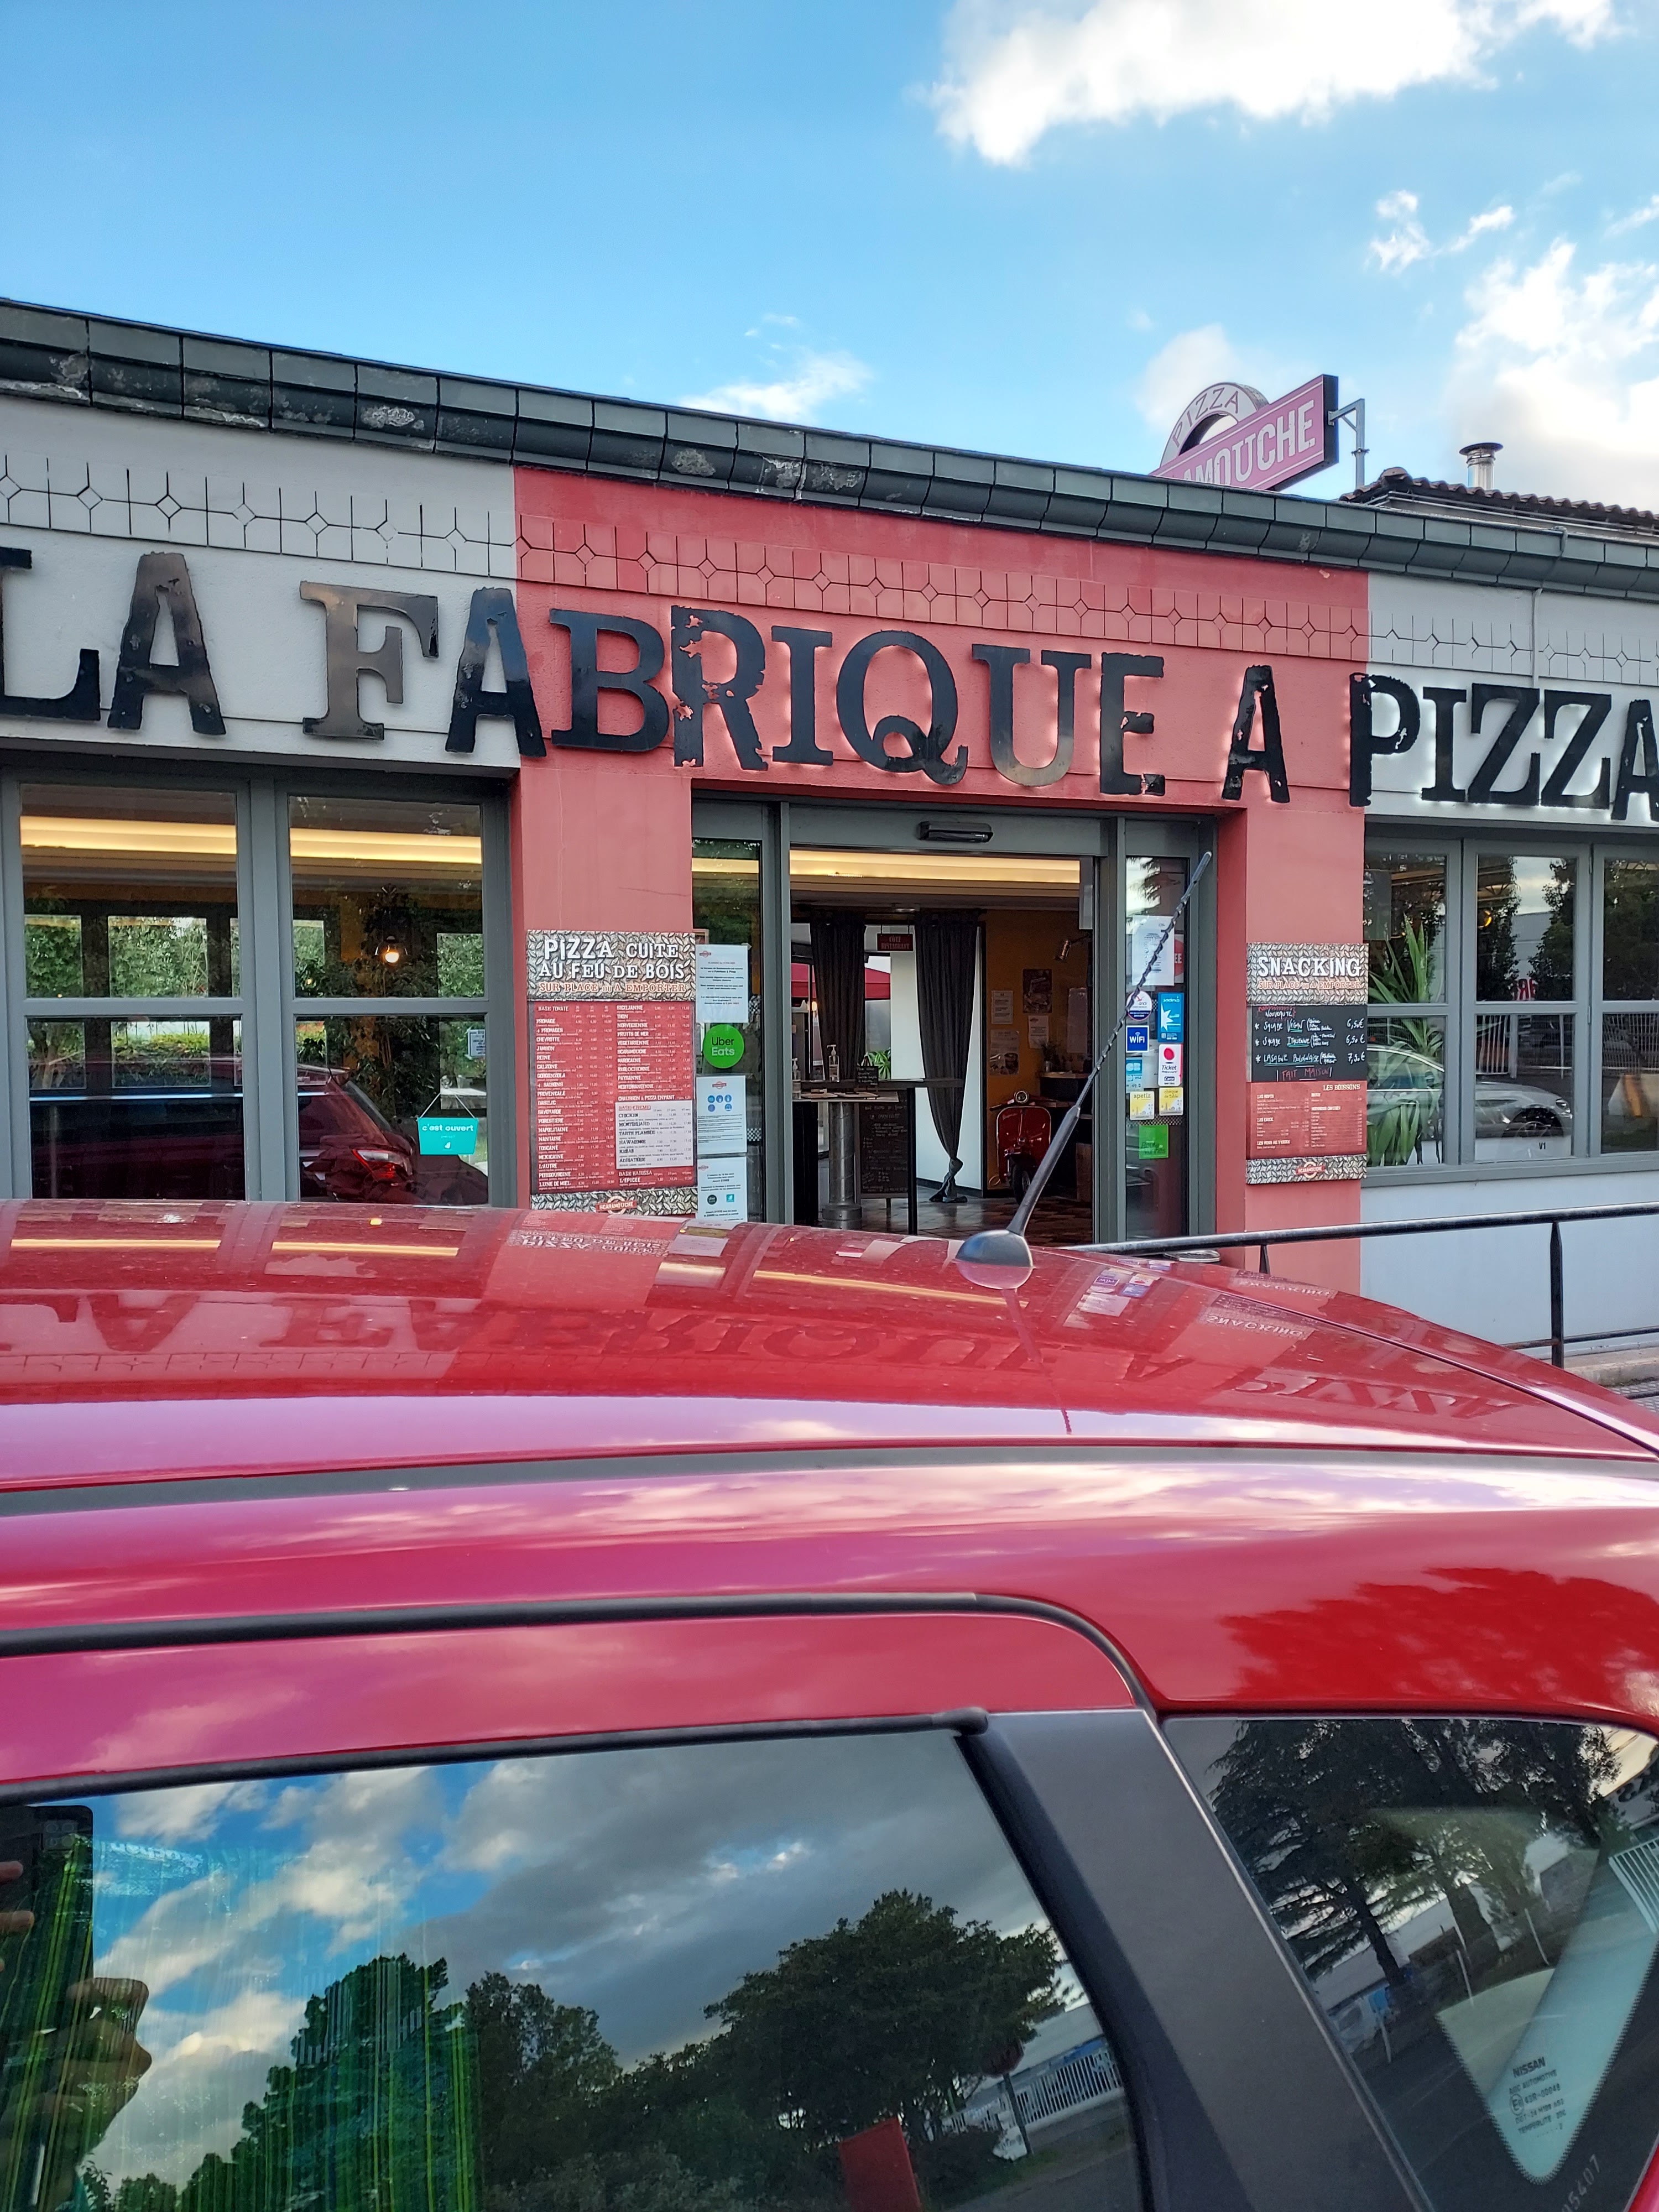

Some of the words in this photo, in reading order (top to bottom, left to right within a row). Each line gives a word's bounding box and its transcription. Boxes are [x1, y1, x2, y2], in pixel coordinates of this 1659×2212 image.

[1171, 387, 1239, 447] PIZZA
[0, 547, 226, 735] LA
[300, 580, 1165, 797] FABRIQUE
[1221, 664, 1290, 803] A
[1348, 671, 1659, 821] PIZZA
[544, 938, 614, 960] PIZZA
[625, 943, 679, 958] CUITE
[539, 963, 563, 978] AU
[571, 963, 604, 979] FEU
[613, 964, 638, 978] DE
[646, 963, 685, 979] BOIS
[1258, 957, 1362, 977] SNACKING
[539, 982, 560, 993] SUR
[563, 982, 599, 993] PLACE
[625, 983, 686, 993] EMPORTER
[1276, 981, 1300, 989] PLACE
[711, 1037, 734, 1046] Uber
[711, 1047, 735, 1056] Eats
[1282, 1068, 1297, 1078] FAIT
[1513, 2056, 1546, 2078] NISSAN
